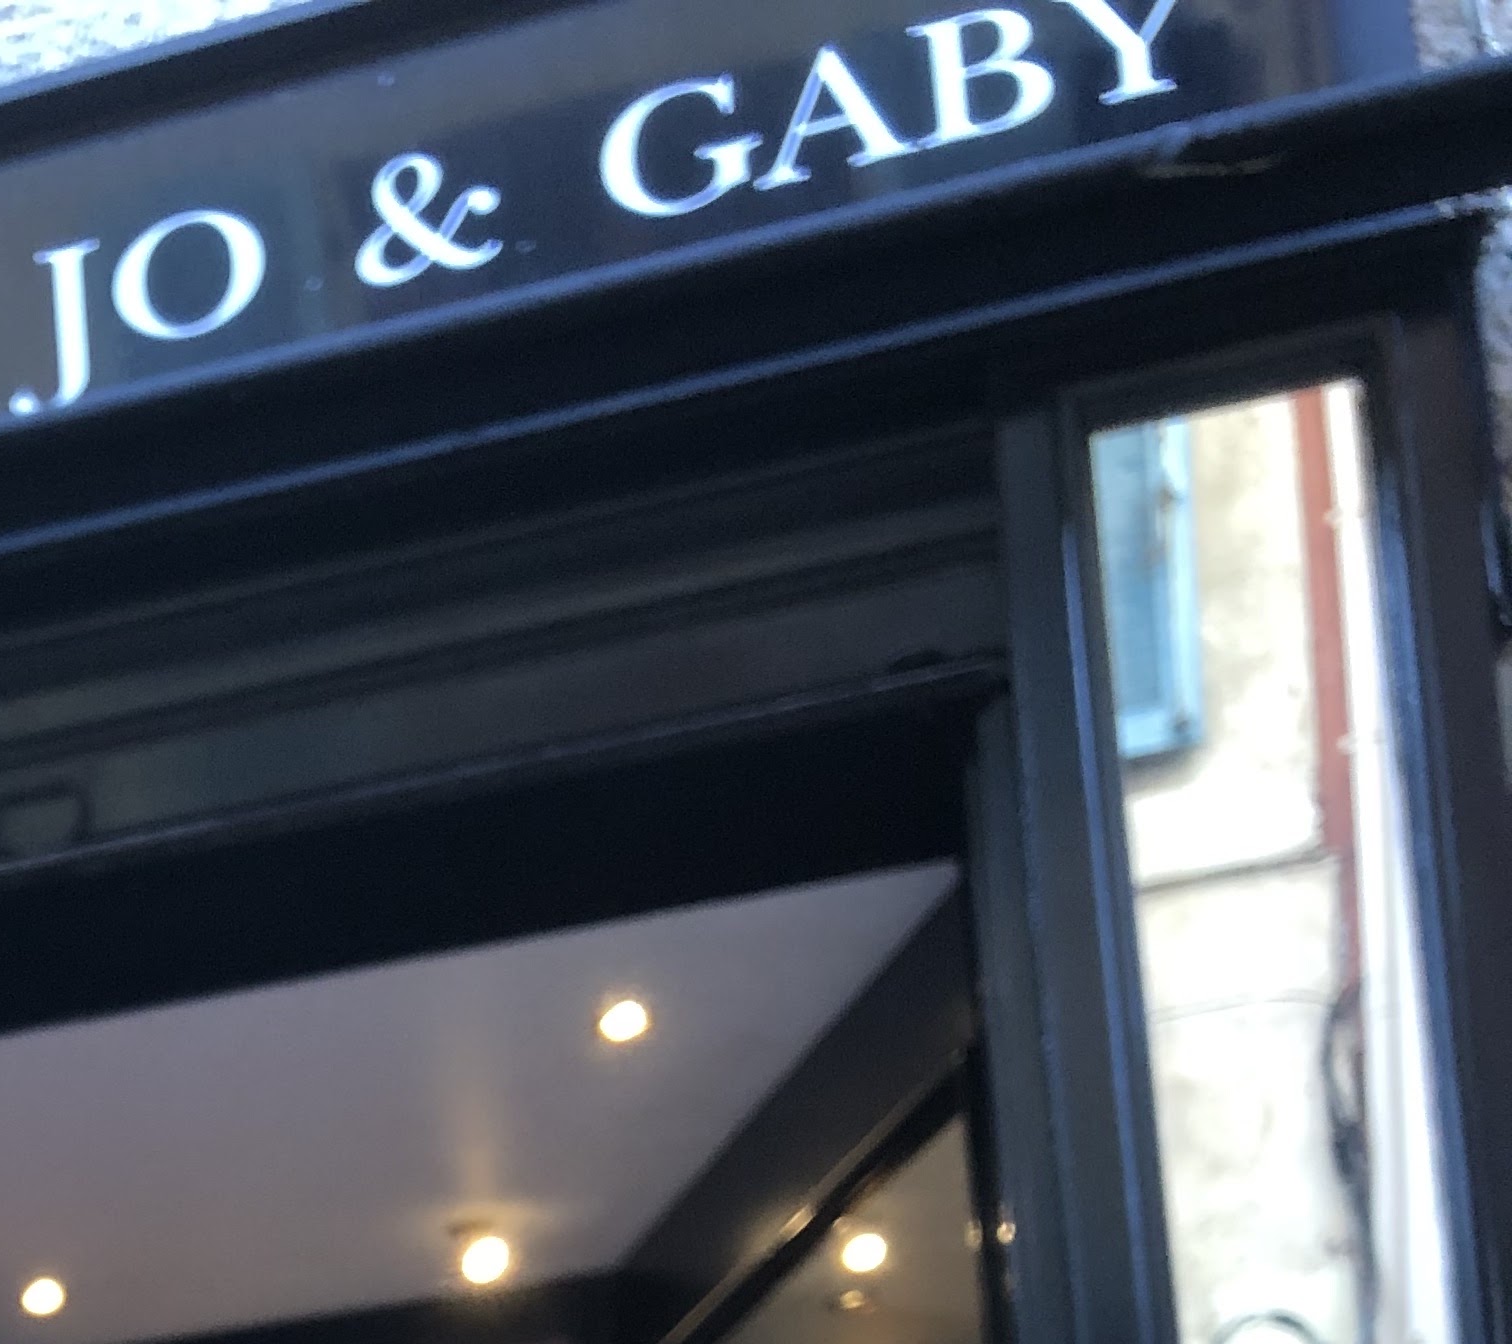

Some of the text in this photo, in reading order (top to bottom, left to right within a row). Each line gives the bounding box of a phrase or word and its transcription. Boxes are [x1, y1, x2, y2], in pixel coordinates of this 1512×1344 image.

[6, 207, 266, 416] JO
[354, 151, 504, 289] &
[599, 0, 1181, 221] GABY
